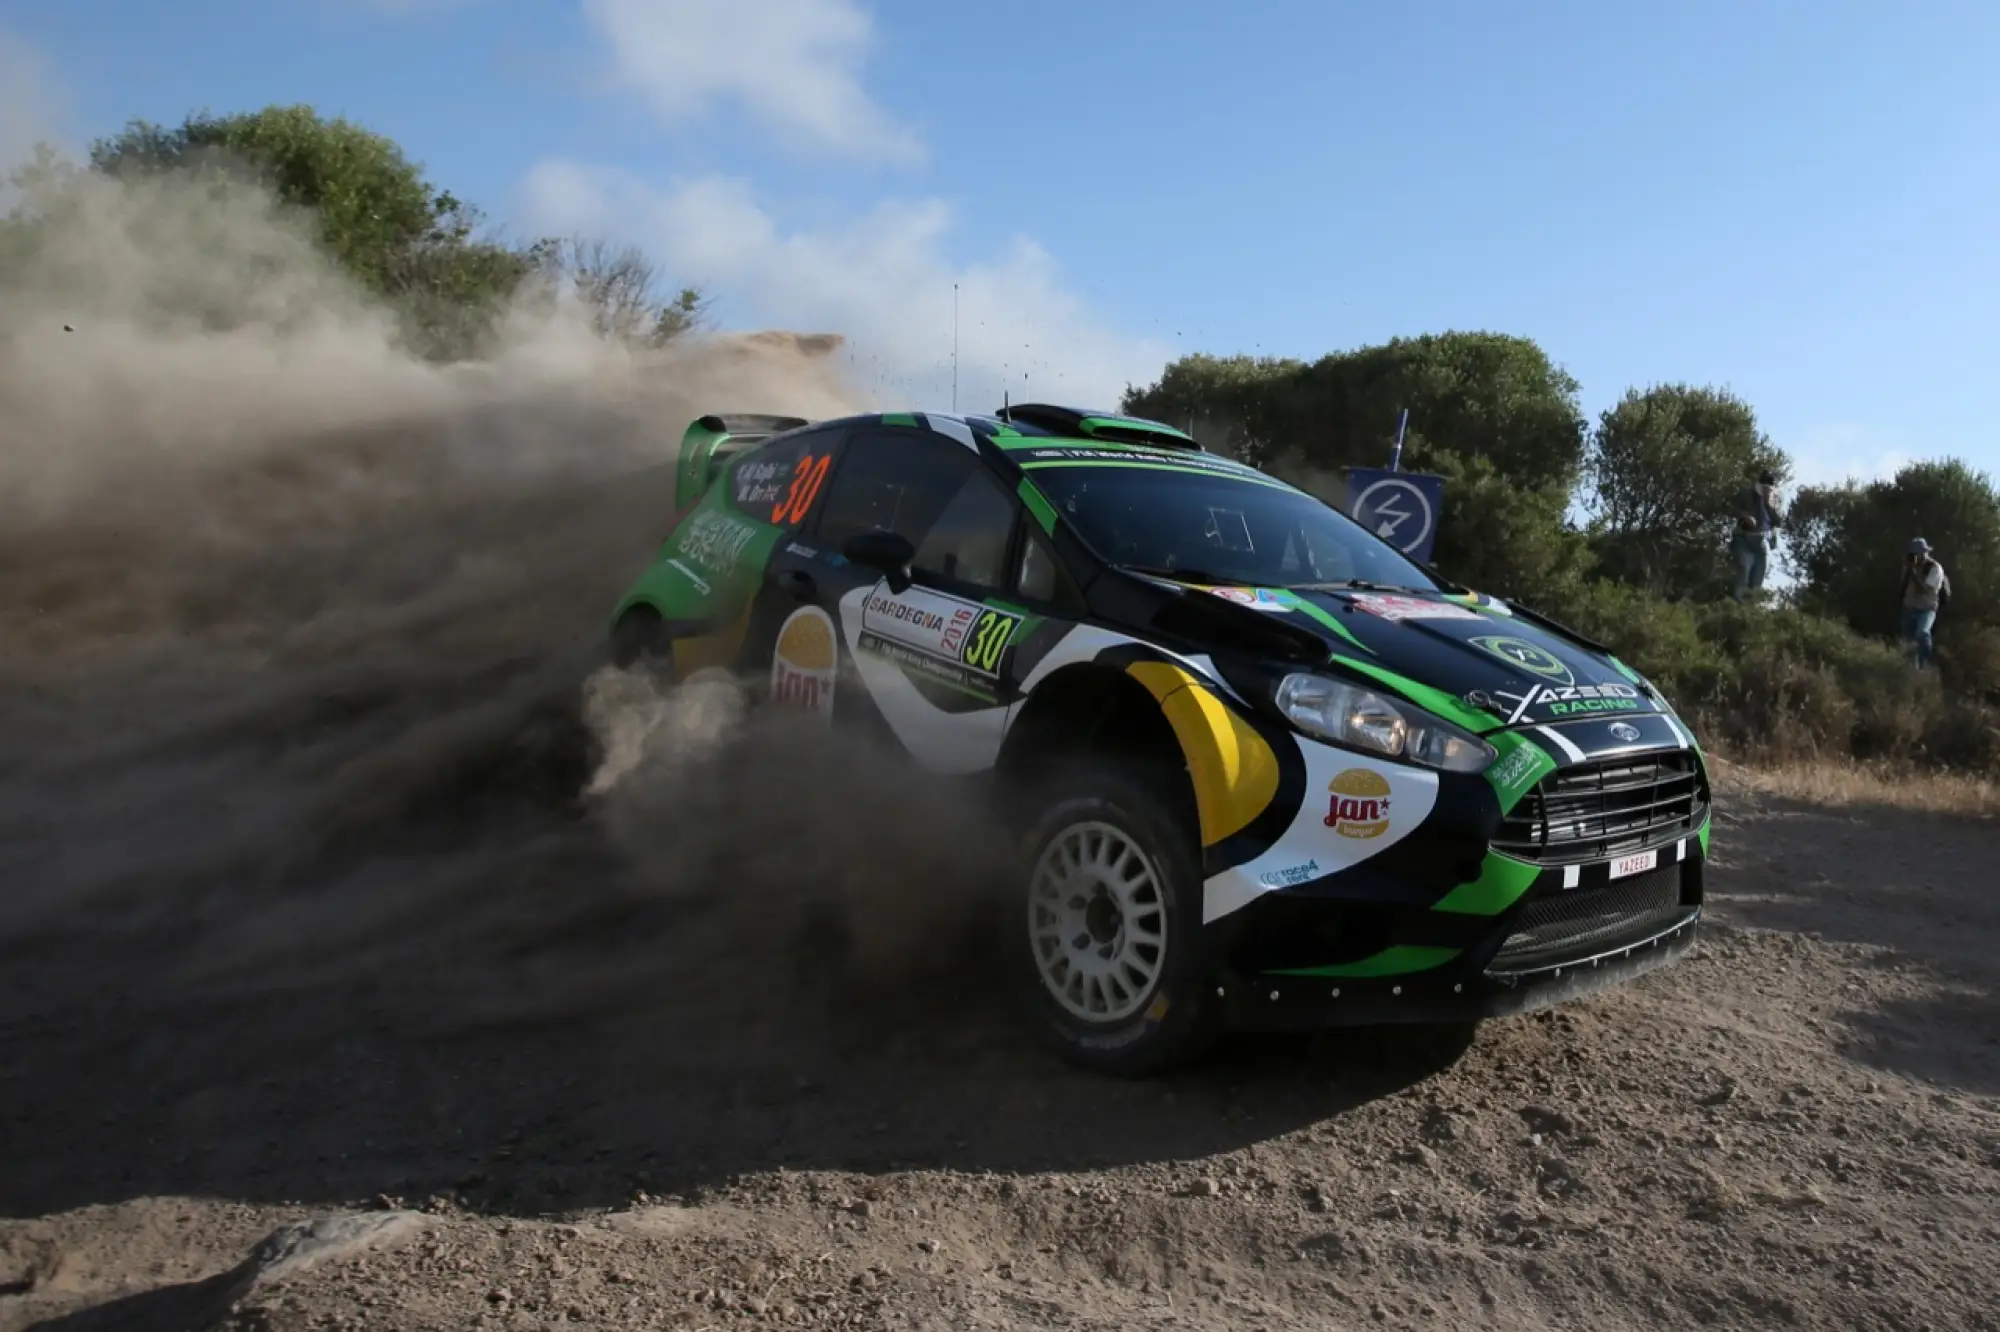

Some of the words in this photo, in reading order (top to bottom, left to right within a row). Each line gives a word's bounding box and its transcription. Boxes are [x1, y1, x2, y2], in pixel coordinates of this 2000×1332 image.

[771, 455, 831, 524] 30
[869, 597, 944, 632] SARDEGNA
[941, 608, 973, 652] 2016
[966, 610, 1013, 671] 30
[1494, 683, 1638, 724] YAZEED
[1549, 699, 1638, 715] RACING
[1619, 855, 1651, 874] YAZEED
